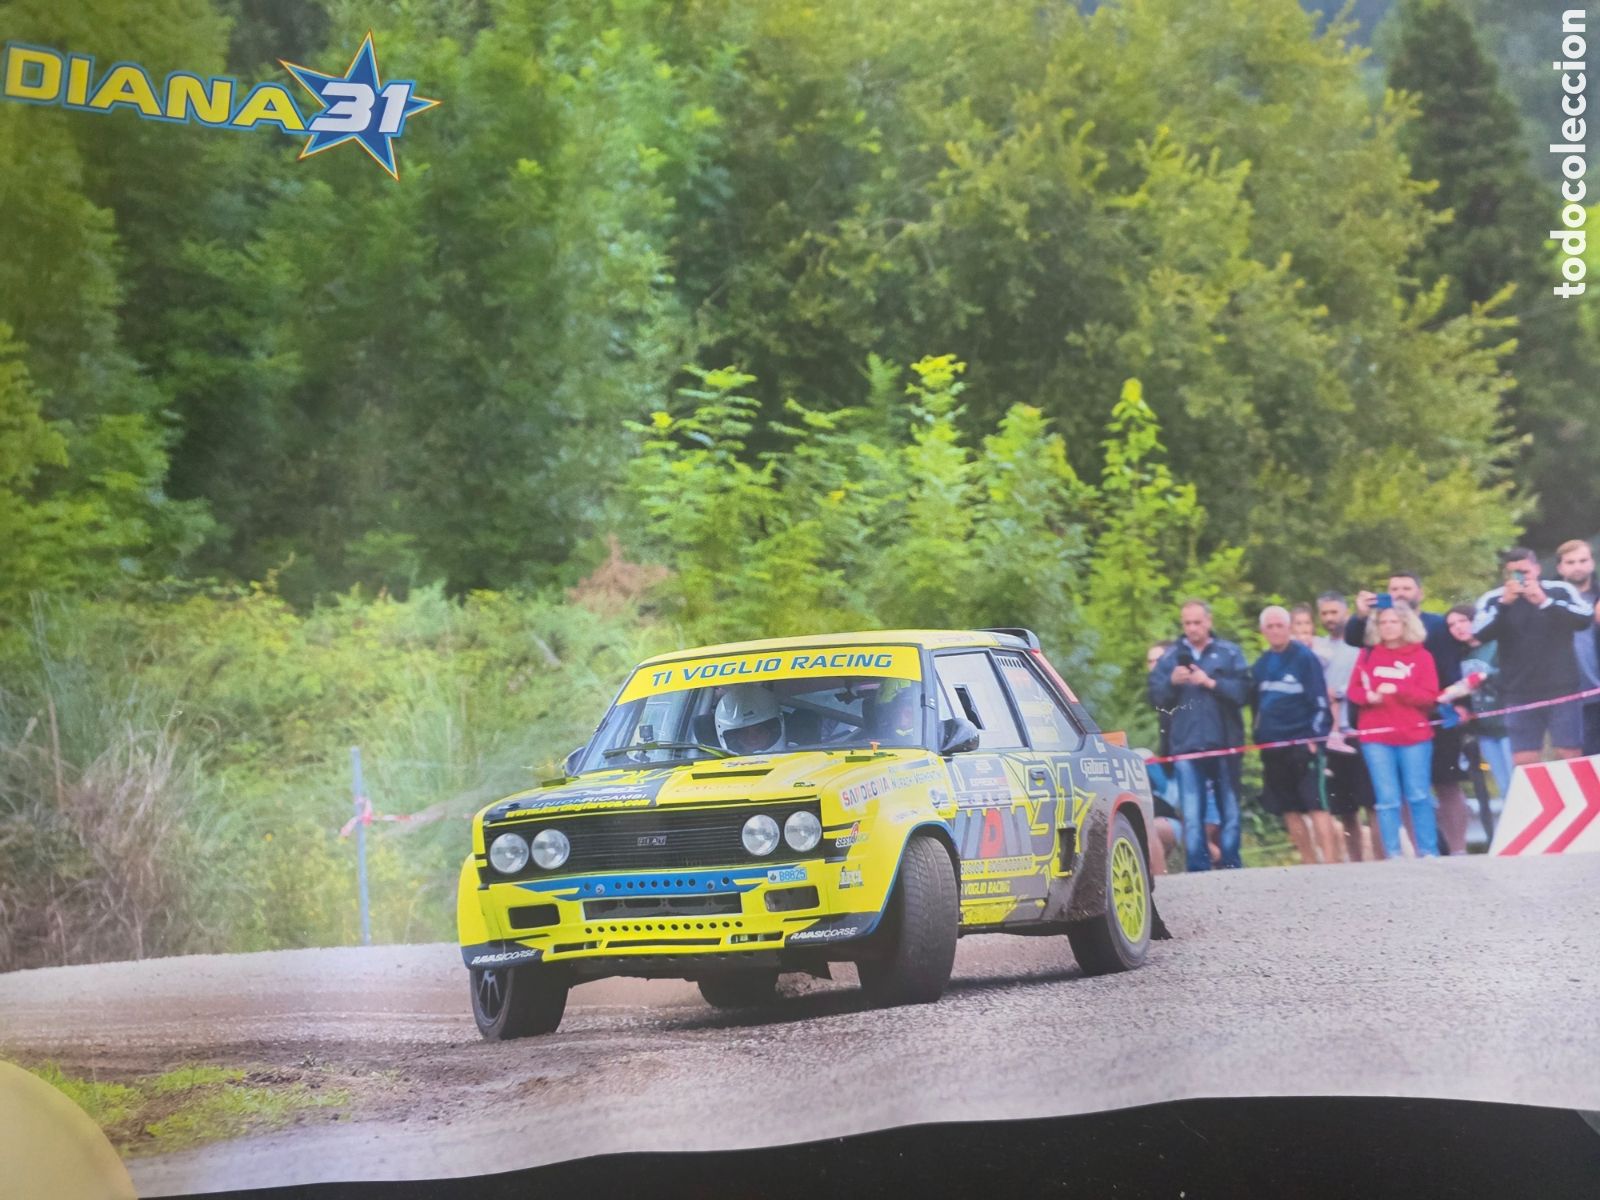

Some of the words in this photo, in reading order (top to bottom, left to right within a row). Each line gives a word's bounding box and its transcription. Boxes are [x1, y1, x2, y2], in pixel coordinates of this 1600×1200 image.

[4, 46, 306, 131] DIANA
[308, 81, 412, 134] 31
[652, 671, 673, 686] TI
[682, 657, 782, 681] VOGLIO
[789, 653, 894, 670] RACING
